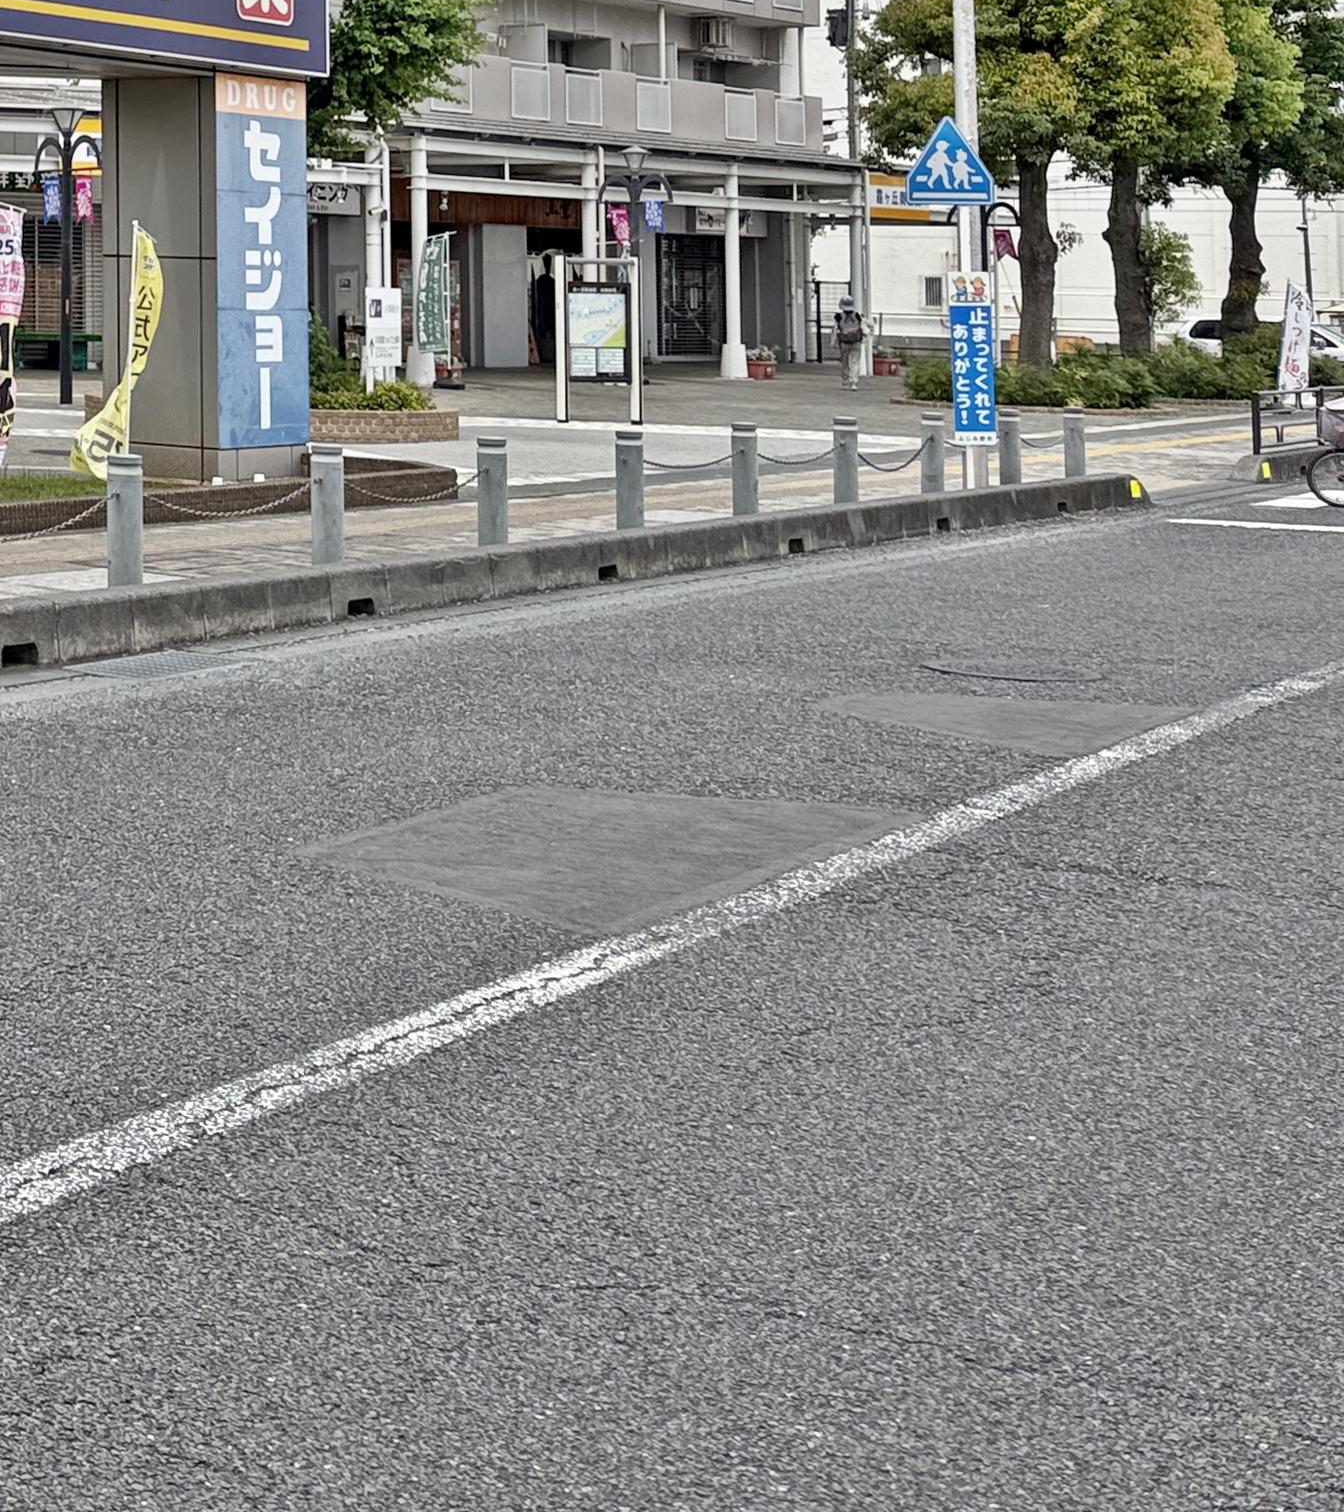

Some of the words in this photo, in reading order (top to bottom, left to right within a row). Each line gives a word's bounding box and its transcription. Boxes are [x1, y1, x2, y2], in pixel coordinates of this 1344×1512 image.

[226, 79, 297, 113] DRUG
[243, 119, 284, 430] セイジョー
[952, 323, 972, 426] ありがとう!
[968, 307, 991, 426] 止まってくれて
